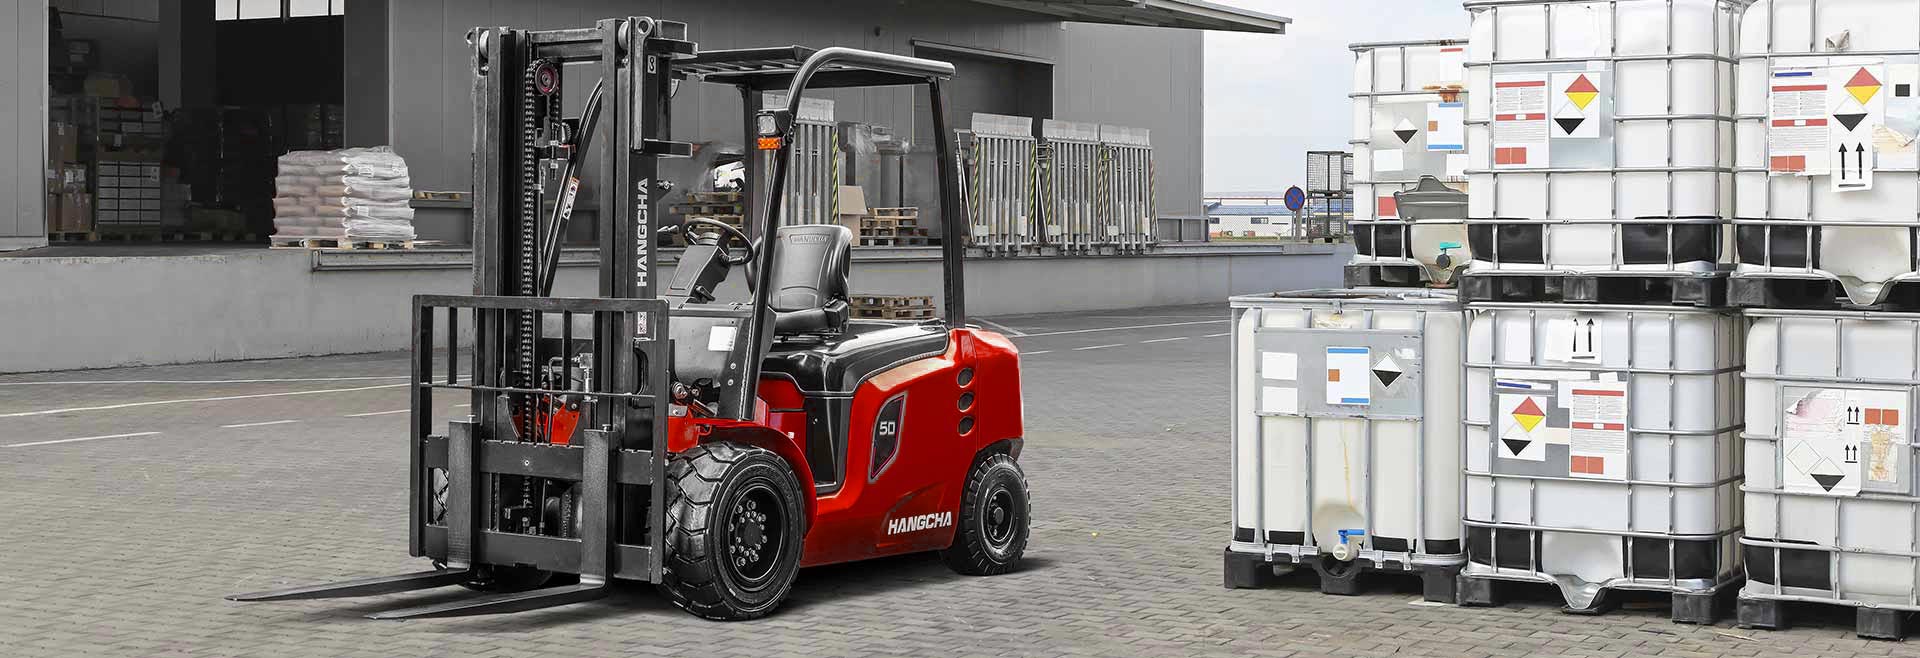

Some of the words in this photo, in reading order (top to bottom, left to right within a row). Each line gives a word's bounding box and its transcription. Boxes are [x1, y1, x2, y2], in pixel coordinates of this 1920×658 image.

[637, 177, 648, 287] HANGCHA
[879, 421, 896, 435] 50
[887, 511, 952, 535] HANGCHA
